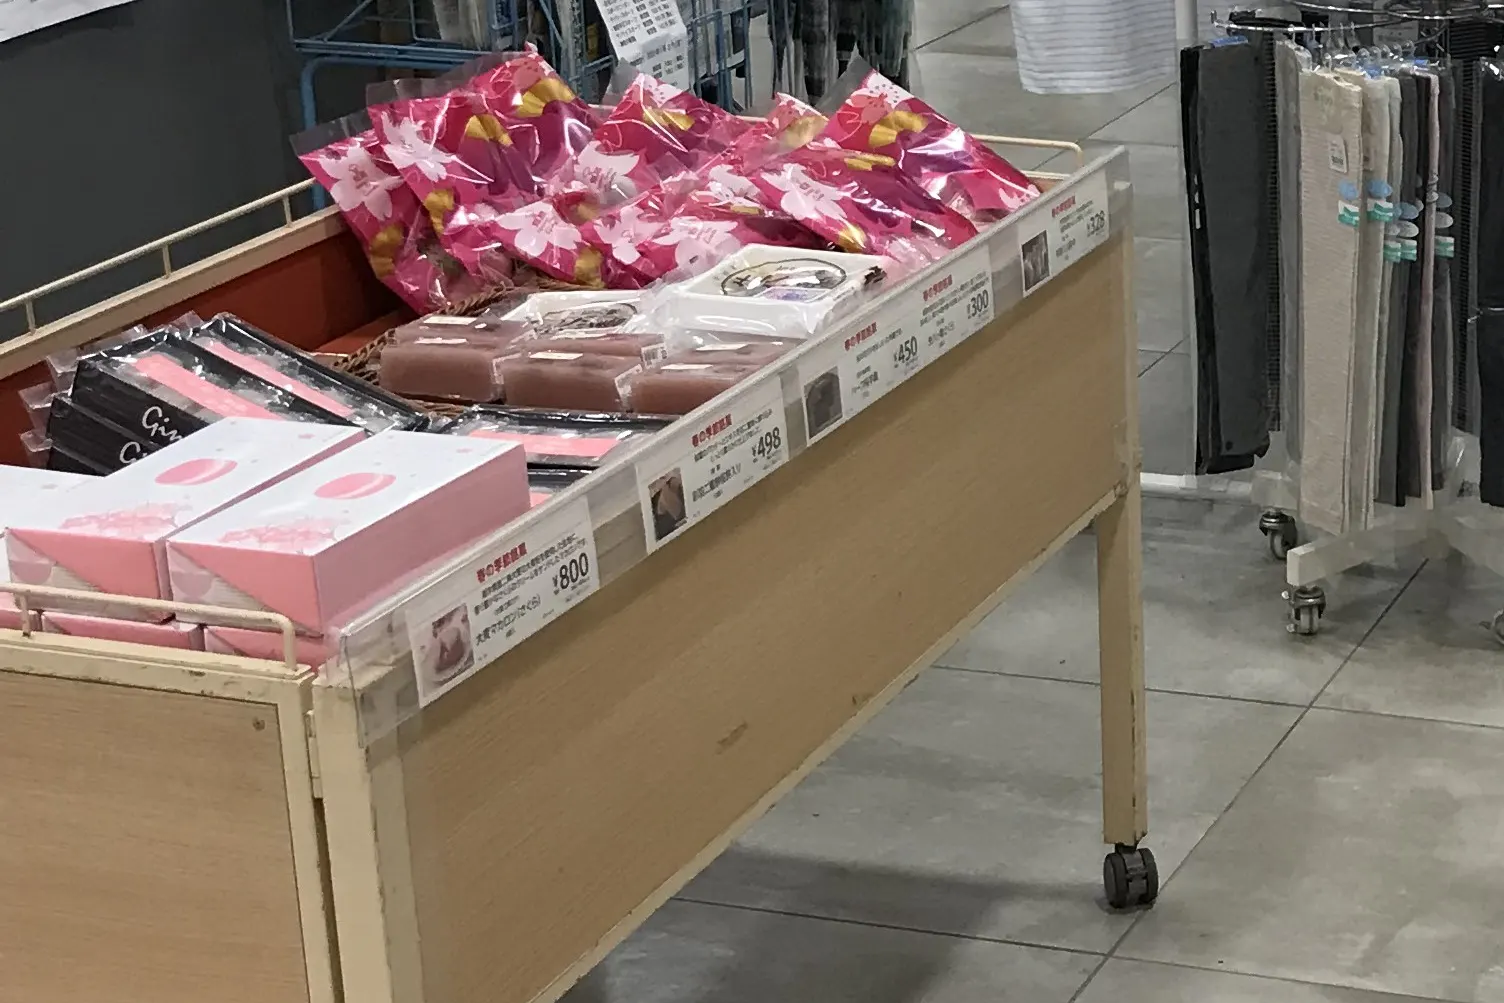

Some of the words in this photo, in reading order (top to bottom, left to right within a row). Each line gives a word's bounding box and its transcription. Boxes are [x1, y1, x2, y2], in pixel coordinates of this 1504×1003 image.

[893, 336, 918, 363] ¥450
[752, 426, 782, 457] ¥498
[552, 552, 589, 590] ¥800
